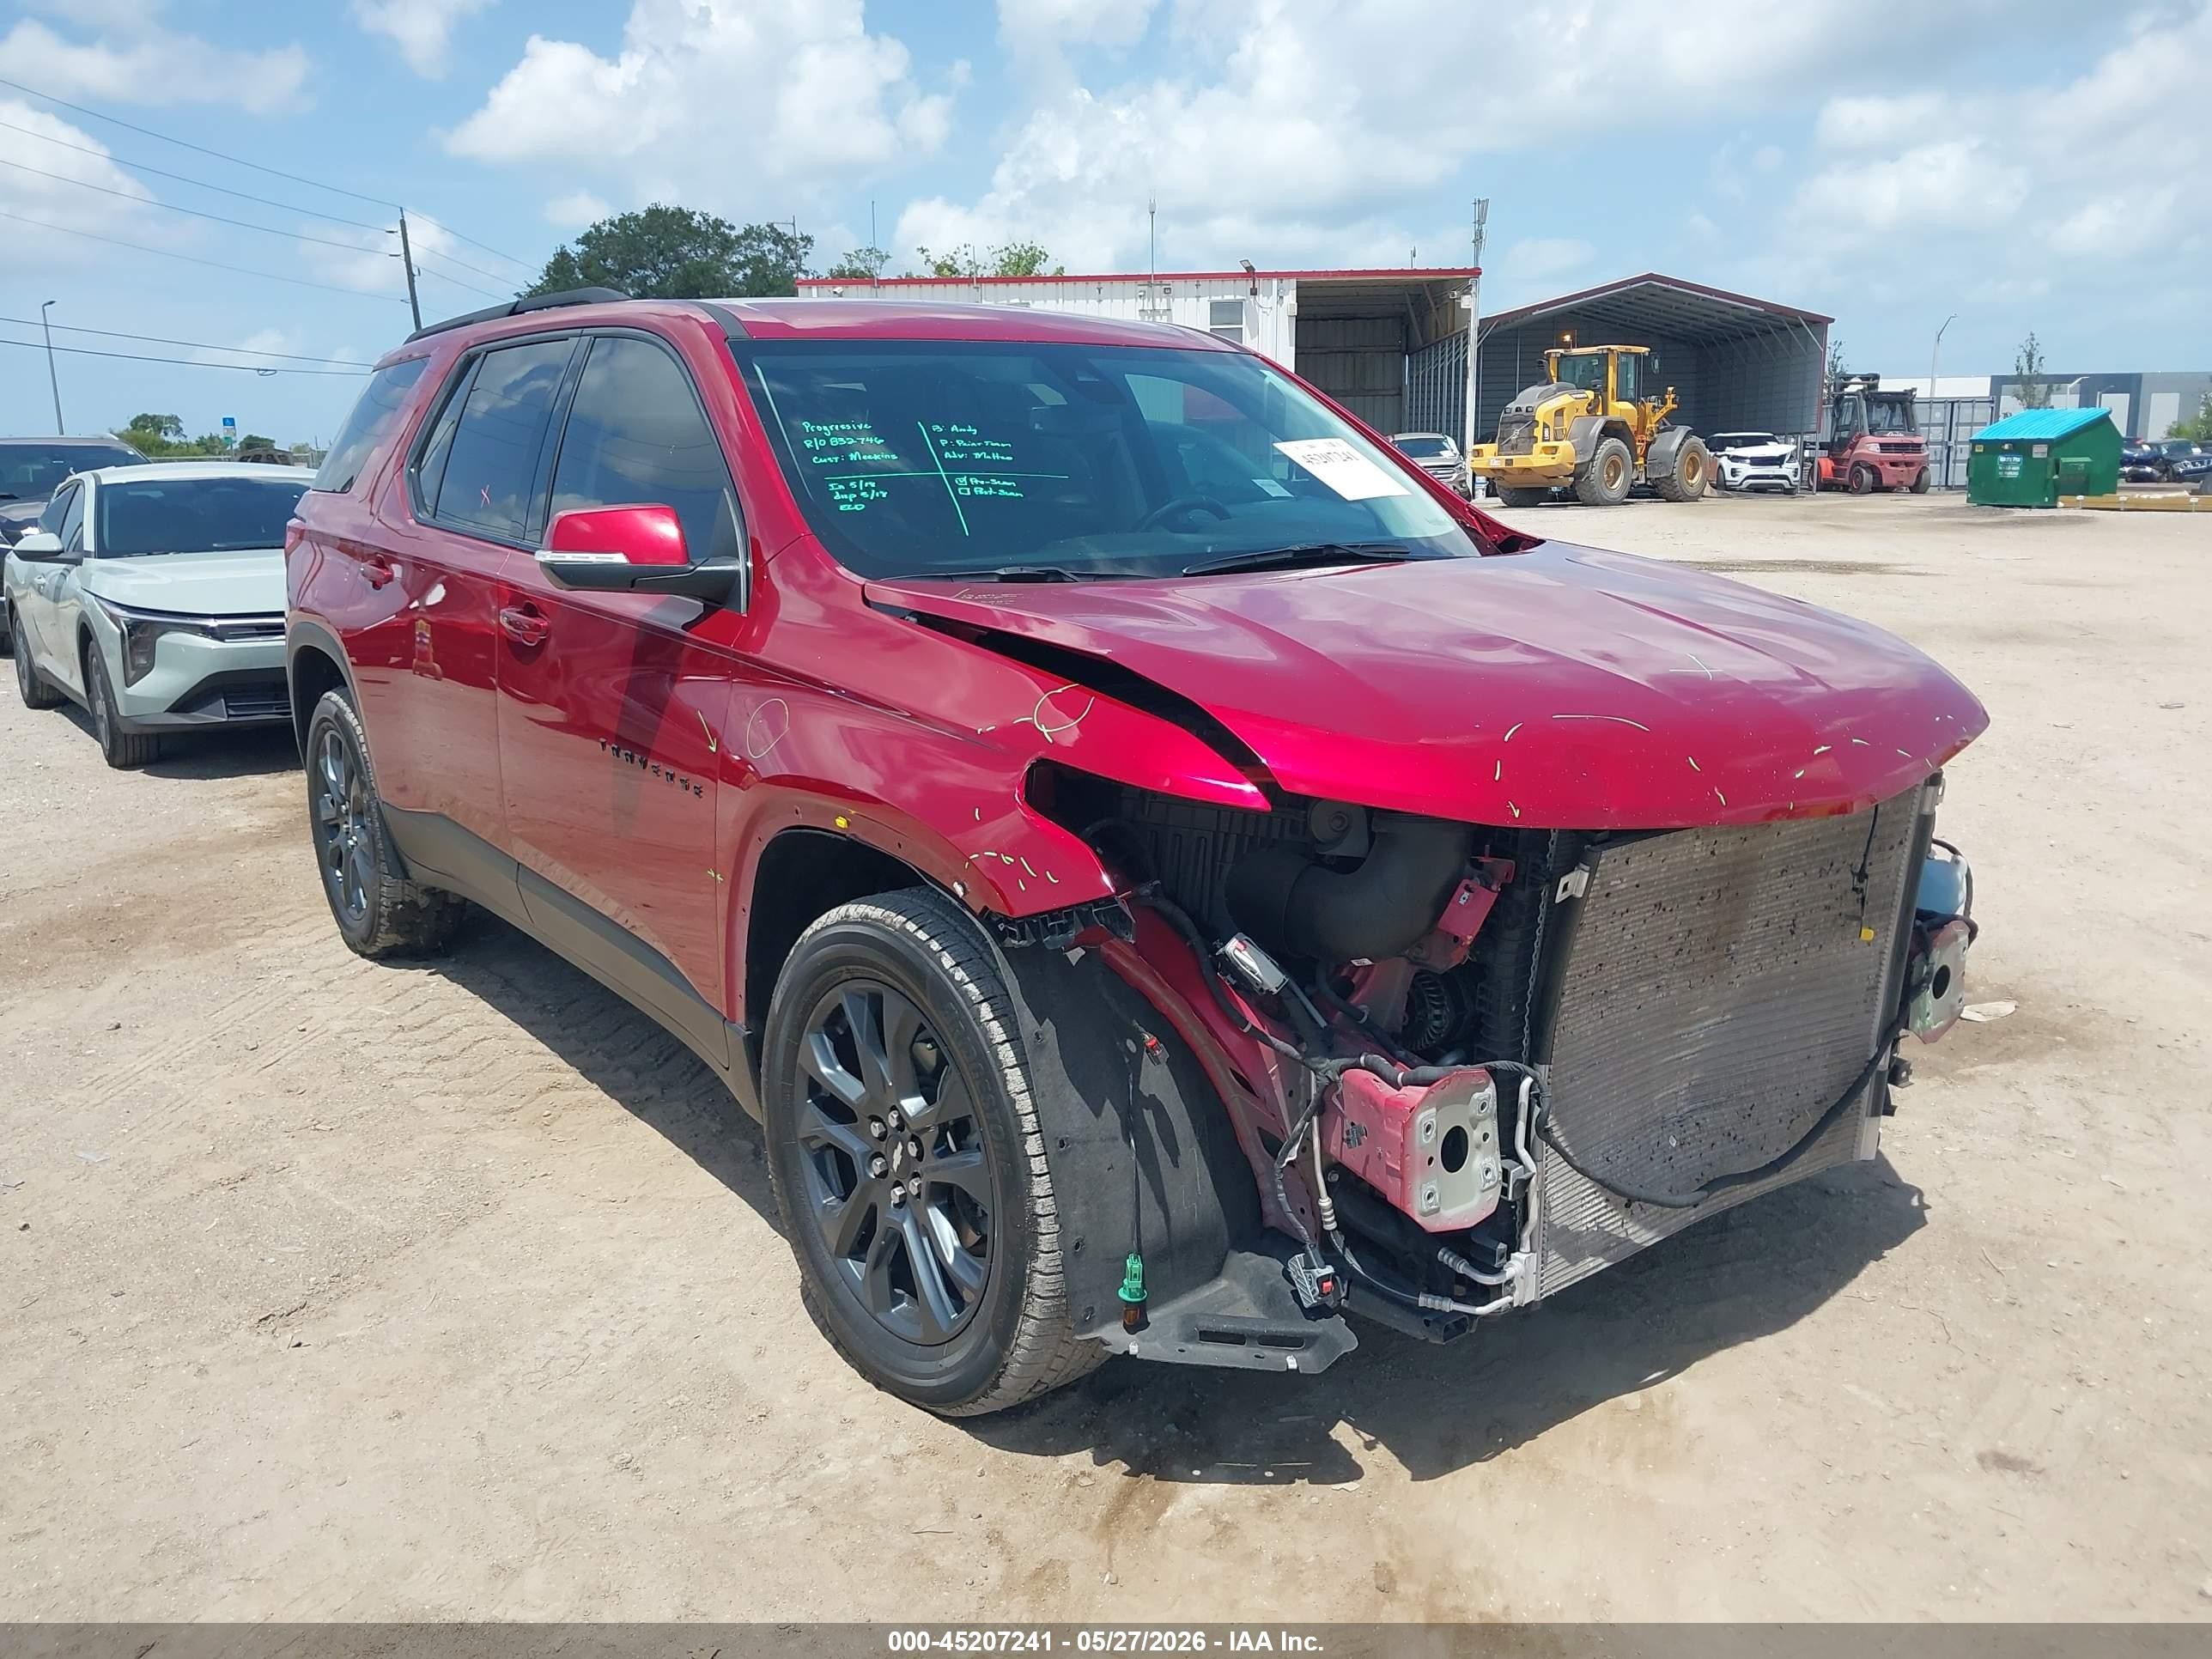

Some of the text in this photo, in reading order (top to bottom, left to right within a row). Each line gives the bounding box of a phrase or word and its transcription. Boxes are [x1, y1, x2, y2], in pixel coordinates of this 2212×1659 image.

[802, 420, 872, 436] Progressive
[951, 424, 977, 435] Andy
[830, 436, 885, 447] 832746
[598, 737, 705, 799] TRAVERSE
